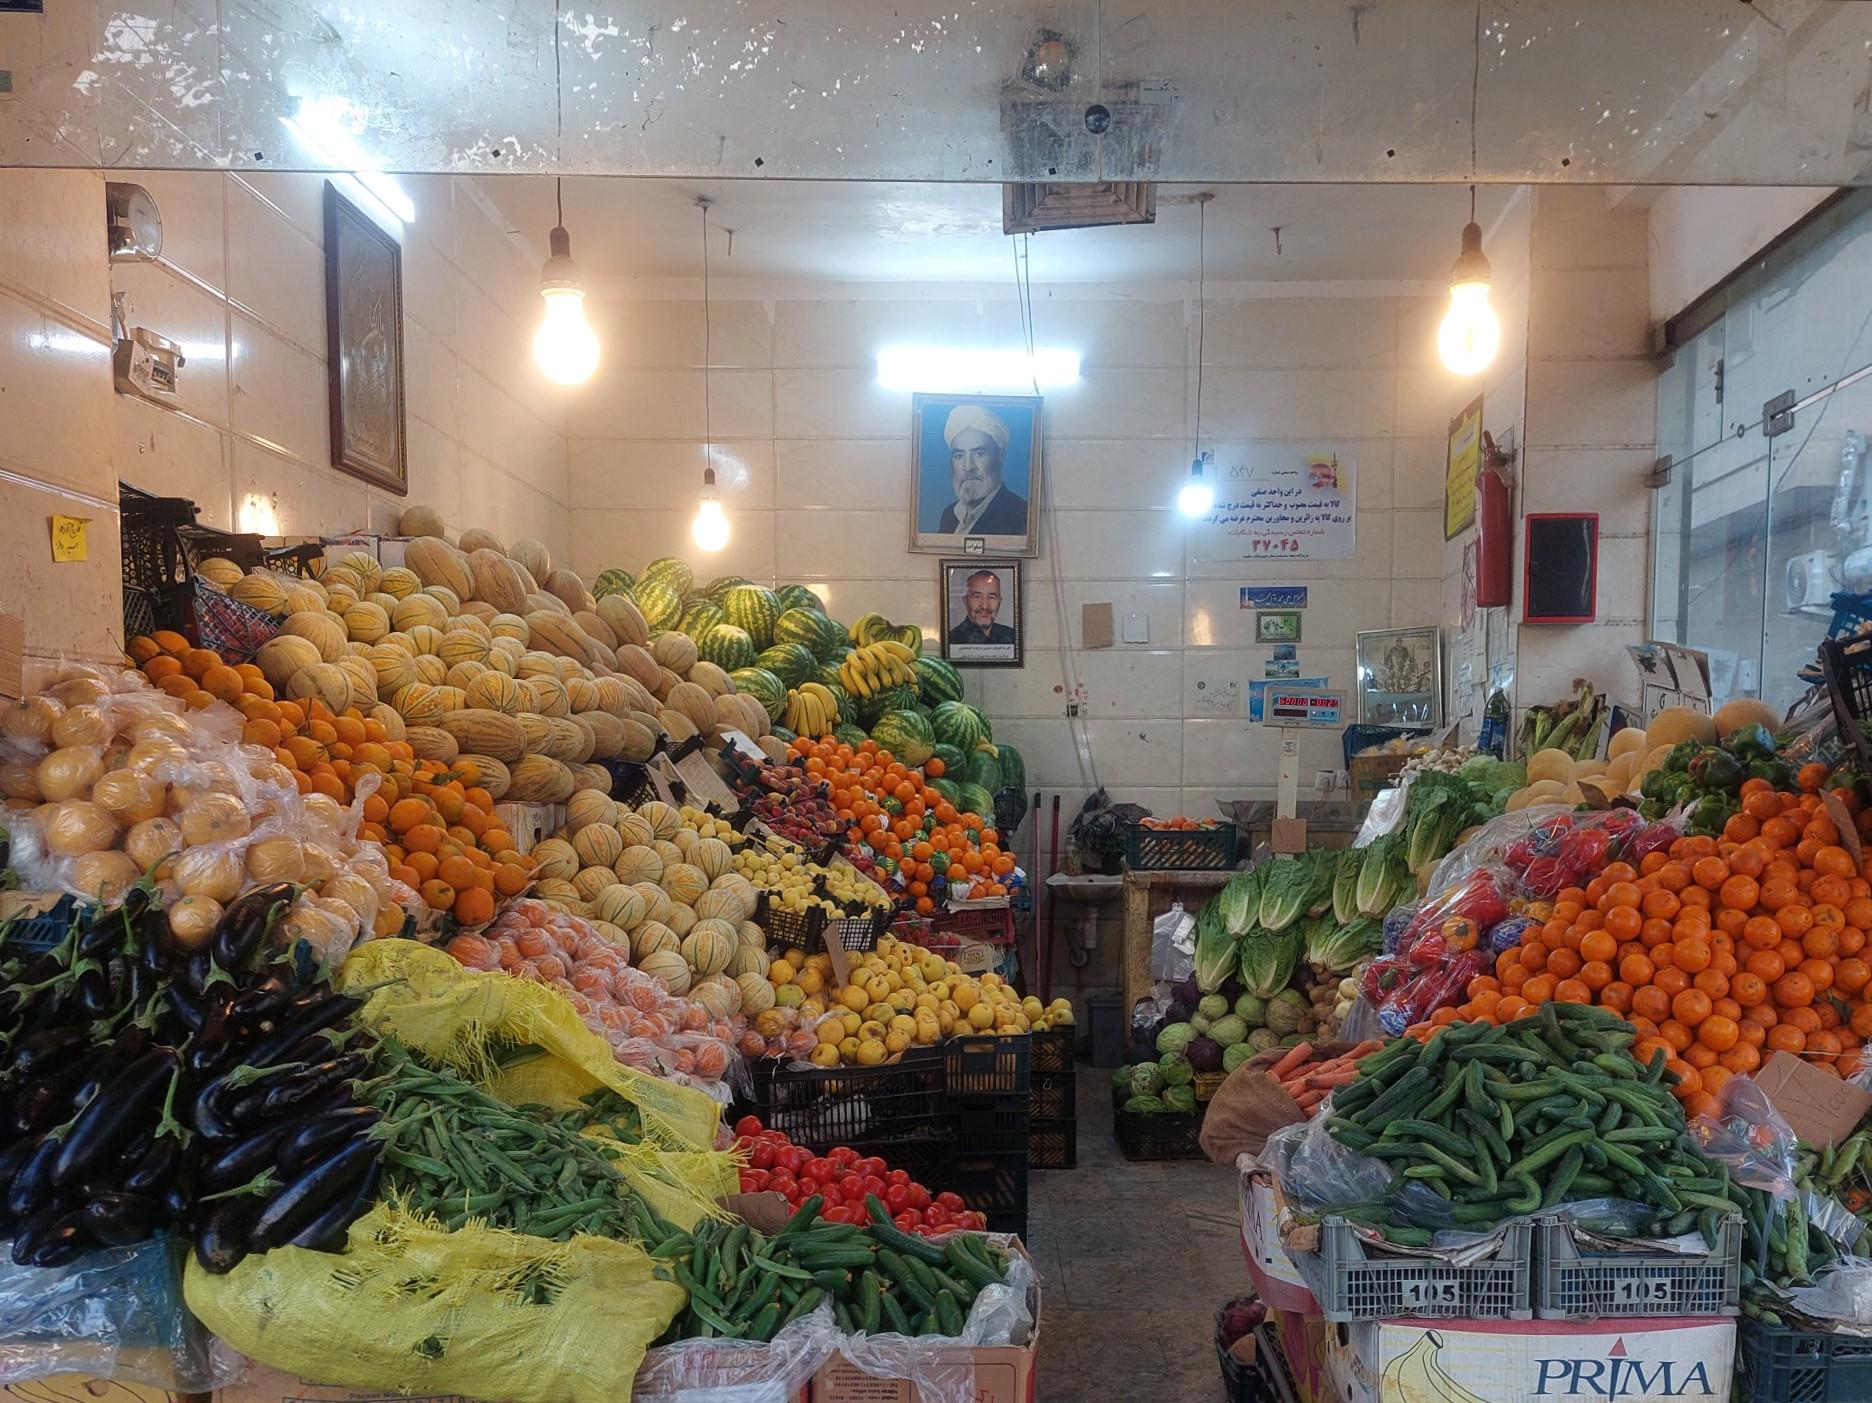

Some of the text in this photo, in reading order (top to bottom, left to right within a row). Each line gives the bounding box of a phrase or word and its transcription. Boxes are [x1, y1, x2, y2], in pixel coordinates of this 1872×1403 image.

[1251, 488, 1268, 497] صنفی
[1268, 488, 1284, 498] واحد
[1308, 501, 1322, 509] قیمت
[1330, 500, 1340, 509] کالا
[1246, 514, 1264, 524] محترم
[1320, 514, 1331, 522] کالا
[1332, 514, 1344, 523] روی
[1408, 1284, 1456, 1302] 105
[1621, 1281, 1668, 1300] 105
[1534, 1337, 1717, 1402] PRIMA
